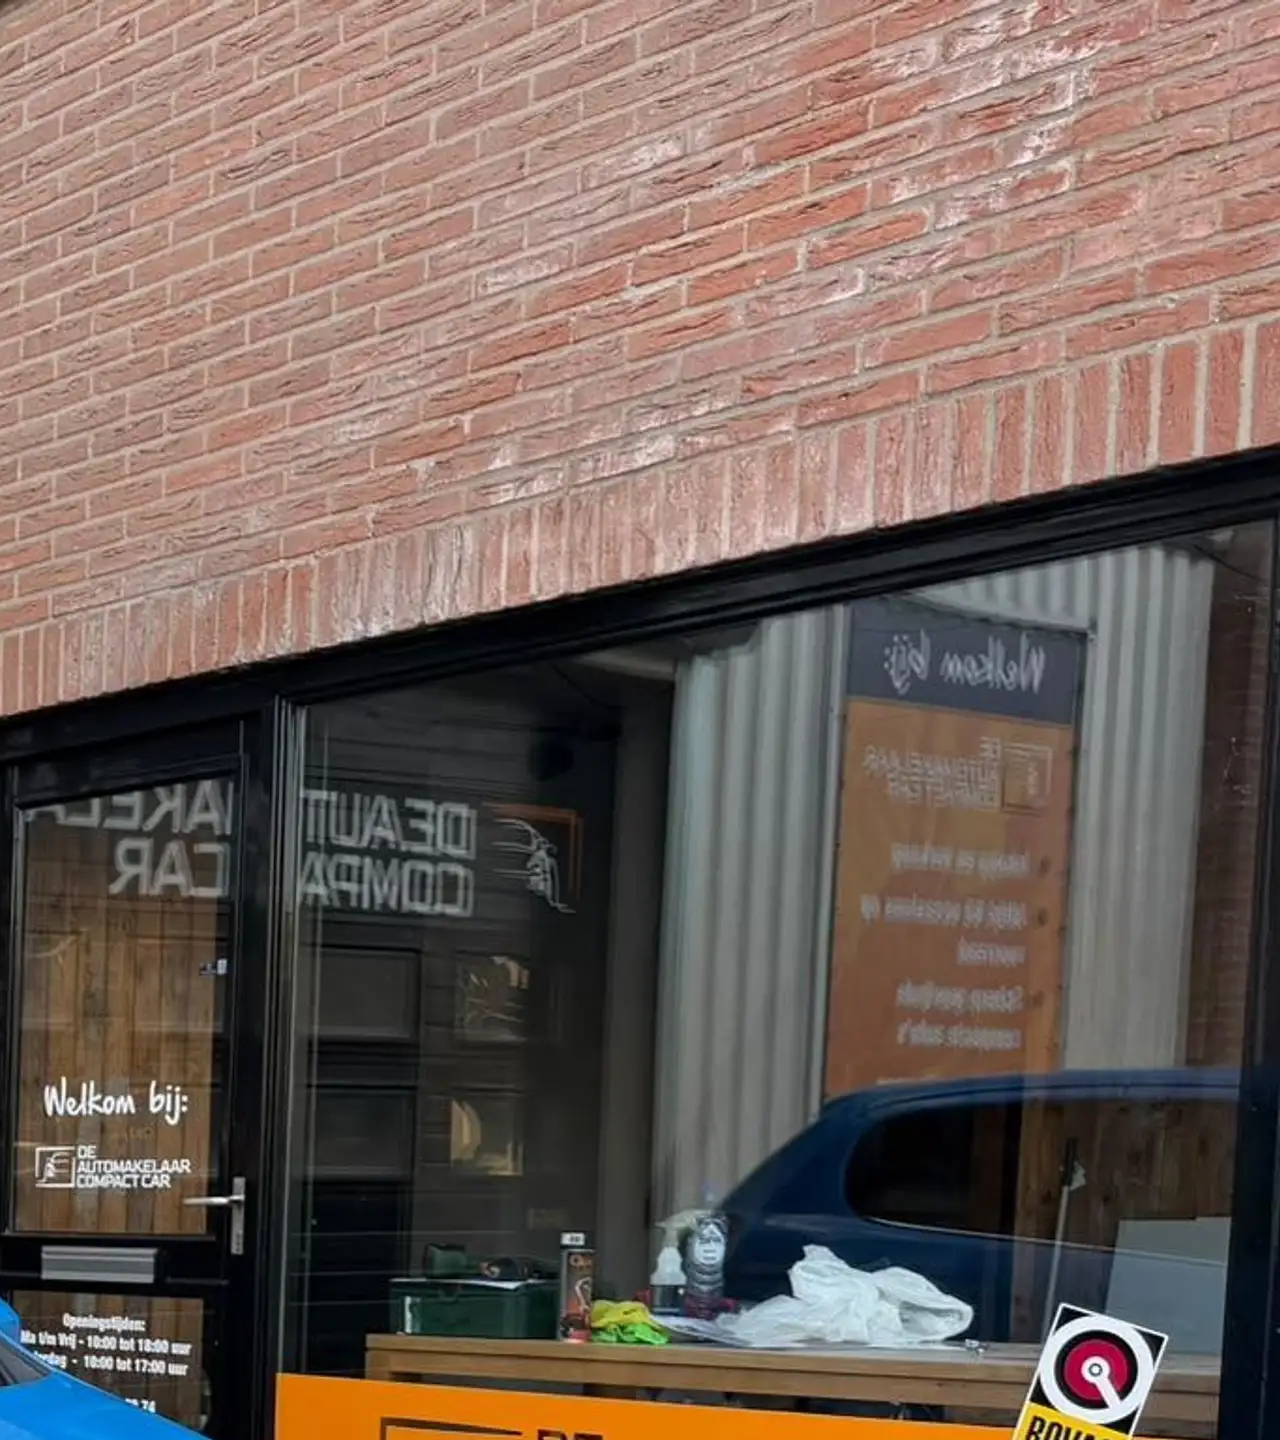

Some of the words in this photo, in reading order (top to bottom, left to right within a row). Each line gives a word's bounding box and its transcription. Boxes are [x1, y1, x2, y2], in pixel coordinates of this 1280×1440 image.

[44, 1076, 136, 1116] Welkom
[149, 1080, 188, 1125] bij:
[77, 1145, 96, 1159] DE
[77, 1159, 191, 1174] AUTOMAKELAAR
[77, 1174, 140, 1188] COMPACT
[141, 1174, 171, 1188] CAR
[63, 1313, 146, 1332] Openingstijden:
[58, 1332, 77, 1349] Vrij
[88, 1335, 116, 1350] 10:00
[120, 1338, 135, 1352] tot
[138, 1339, 169, 1354] 18:00
[171, 1342, 191, 1356] uur
[116, 1357, 131, 1372] tot
[135, 1358, 166, 1374] 17:00
[168, 1362, 188, 1376] uur
